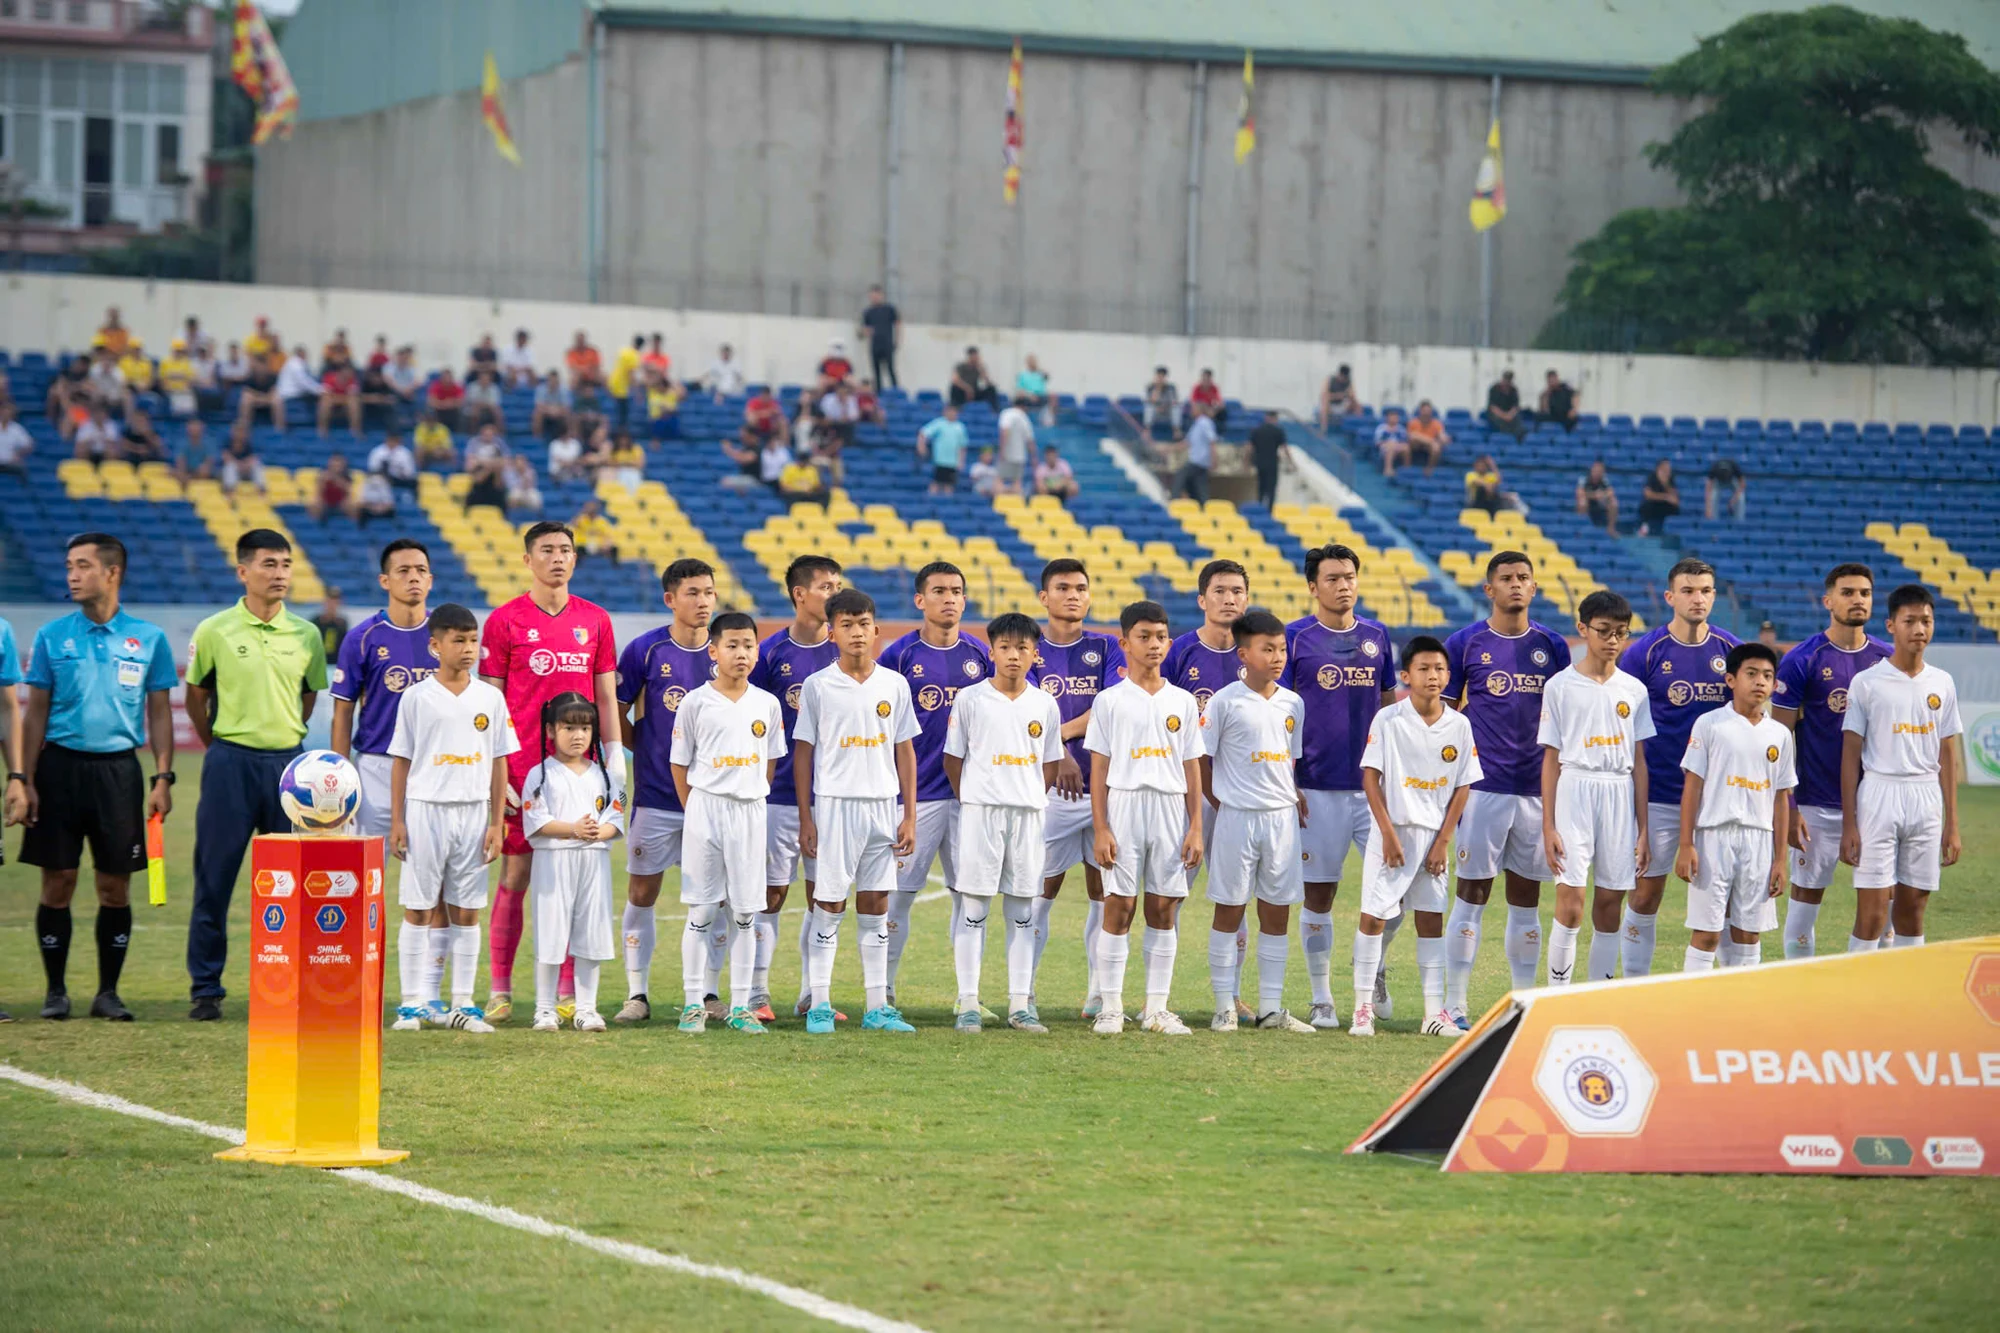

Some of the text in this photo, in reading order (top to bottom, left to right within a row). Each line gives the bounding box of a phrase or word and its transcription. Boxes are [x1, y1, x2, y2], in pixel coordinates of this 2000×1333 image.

[557, 652, 590, 665] T&T
[558, 665, 588, 673] HOMES
[1344, 666, 1375, 679] T&T
[1065, 676, 1098, 688] T&T
[1344, 679, 1375, 687] HOMES
[1513, 674, 1546, 687] T&T
[1694, 682, 1727, 695] T&T
[263, 945, 283, 954] SHINE
[317, 945, 342, 954] SHINE
[257, 954, 289, 964] TOGETHER
[309, 955, 351, 964] TOGETHER
[1572, 1060, 1614, 1075] HANOI
[1686, 1049, 2000, 1087] LPBANK V.LE
[1787, 1143, 1836, 1158] Wika
